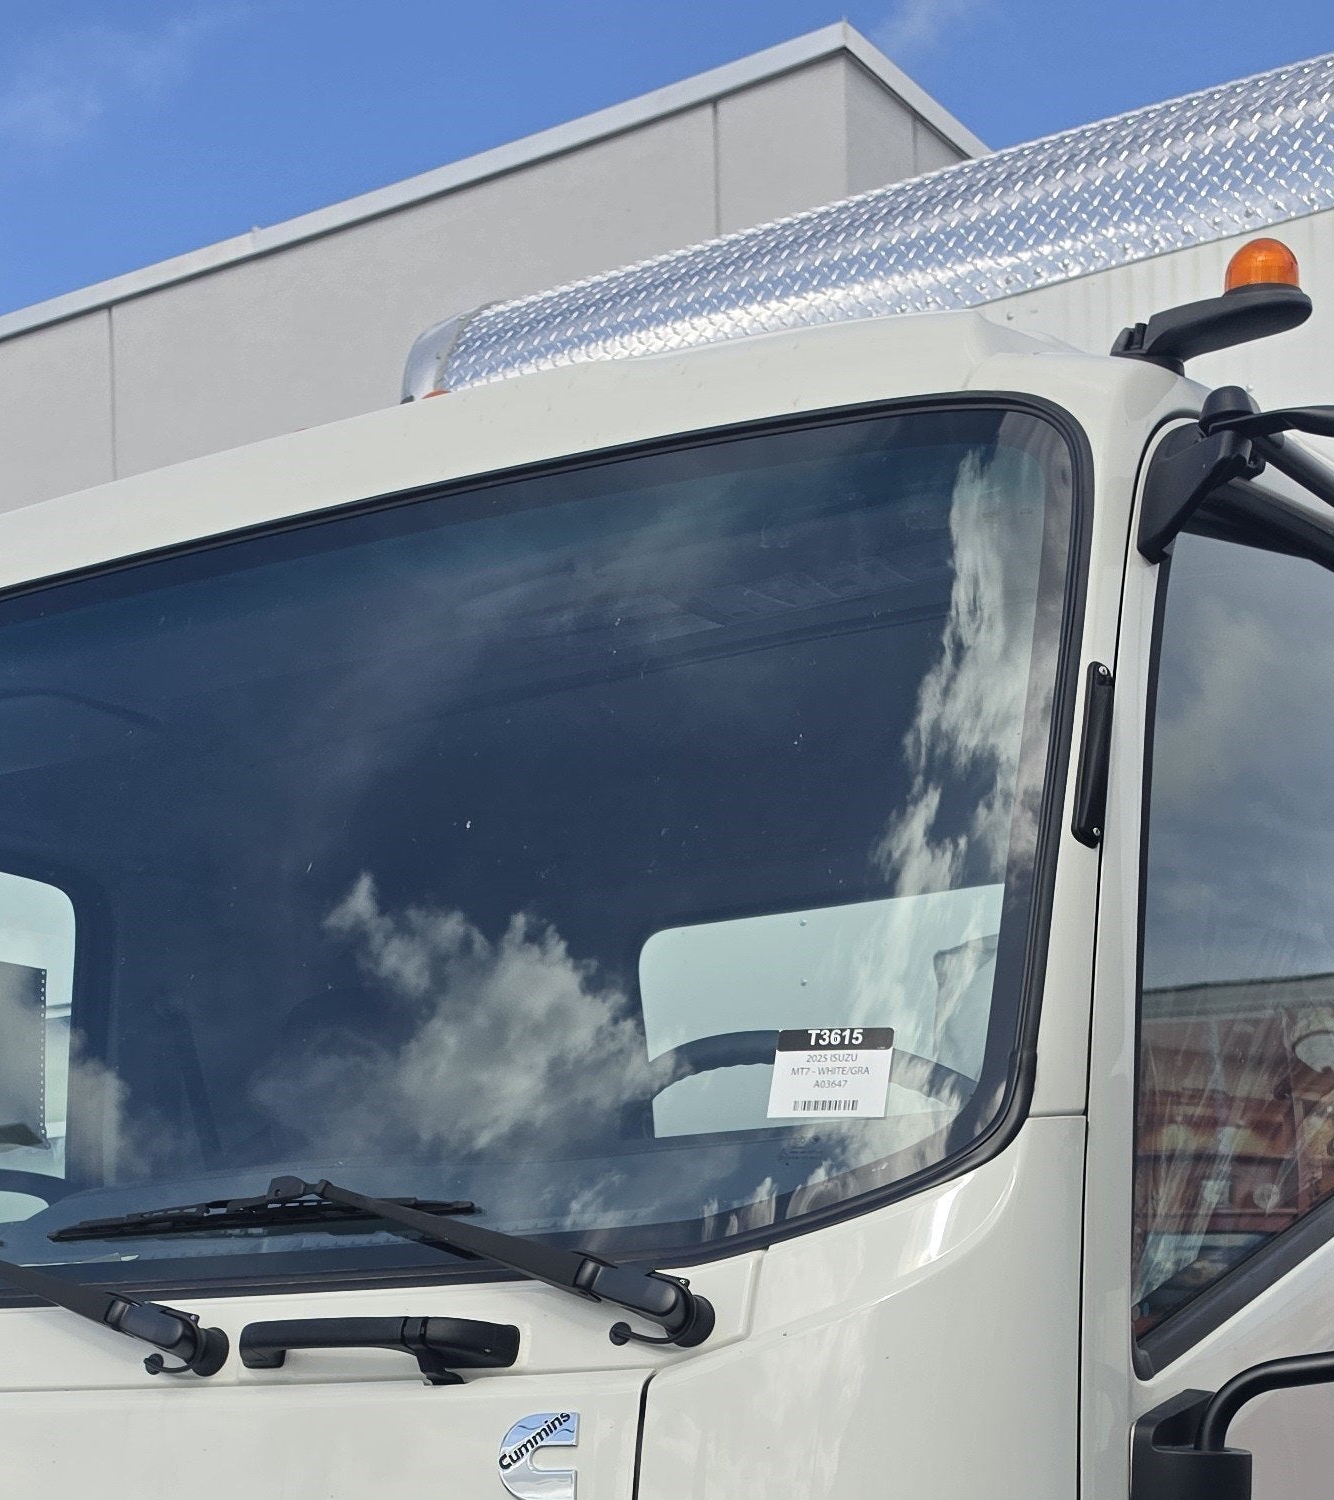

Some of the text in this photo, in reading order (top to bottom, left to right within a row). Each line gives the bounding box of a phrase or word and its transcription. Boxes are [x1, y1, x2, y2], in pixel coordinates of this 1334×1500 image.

[807, 1028, 864, 1046] T3615
[806, 1053, 858, 1063] 2025 ISUZU
[790, 1067, 810, 1076] MT7
[818, 1066, 870, 1076] WHITE/GRA
[813, 1080, 848, 1089] A03647
[498, 1412, 571, 1470] Cummins
